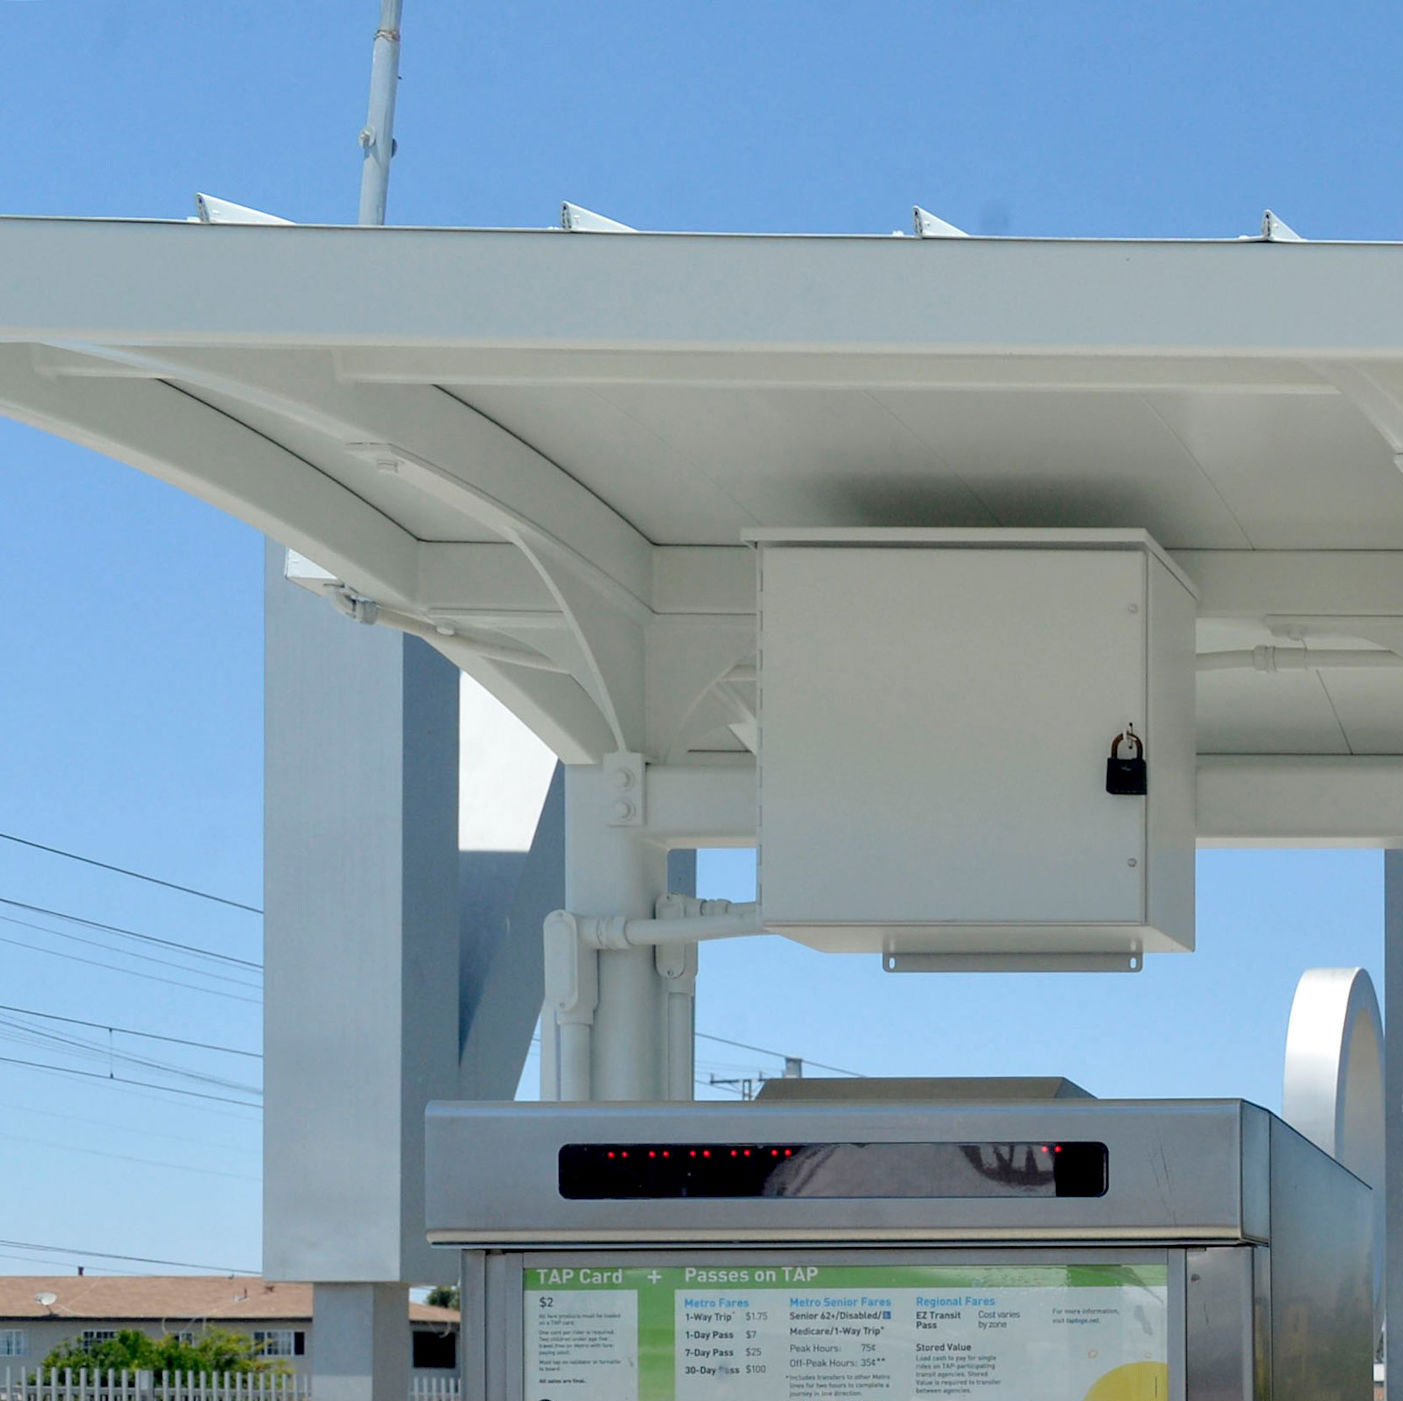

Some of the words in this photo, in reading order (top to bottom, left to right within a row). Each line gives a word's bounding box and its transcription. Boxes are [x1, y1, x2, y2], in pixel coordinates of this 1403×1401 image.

[537, 1269, 575, 1285] TAP
[579, 1269, 623, 1285] Card
[684, 1268, 750, 1283] Passes
[754, 1269, 776, 1282] on
[780, 1268, 818, 1282] TAP
[539, 1296, 554, 1309] $2
[684, 1299, 716, 1308] Metro
[718, 1299, 749, 1308] Fares
[685, 1313, 711, 1322] 1-Way
[745, 1312, 768, 1322] $1.75
[685, 1331, 711, 1341] 1-Day
[712, 1331, 734, 1340] Pass
[746, 1330, 756, 1340] $7
[685, 1348, 711, 1358] 7-Day
[712, 1348, 734, 1357] Pass
[745, 1347, 762, 1358] $25
[685, 1366, 716, 1376] 30-Day
[745, 1365, 767, 1375] $100
